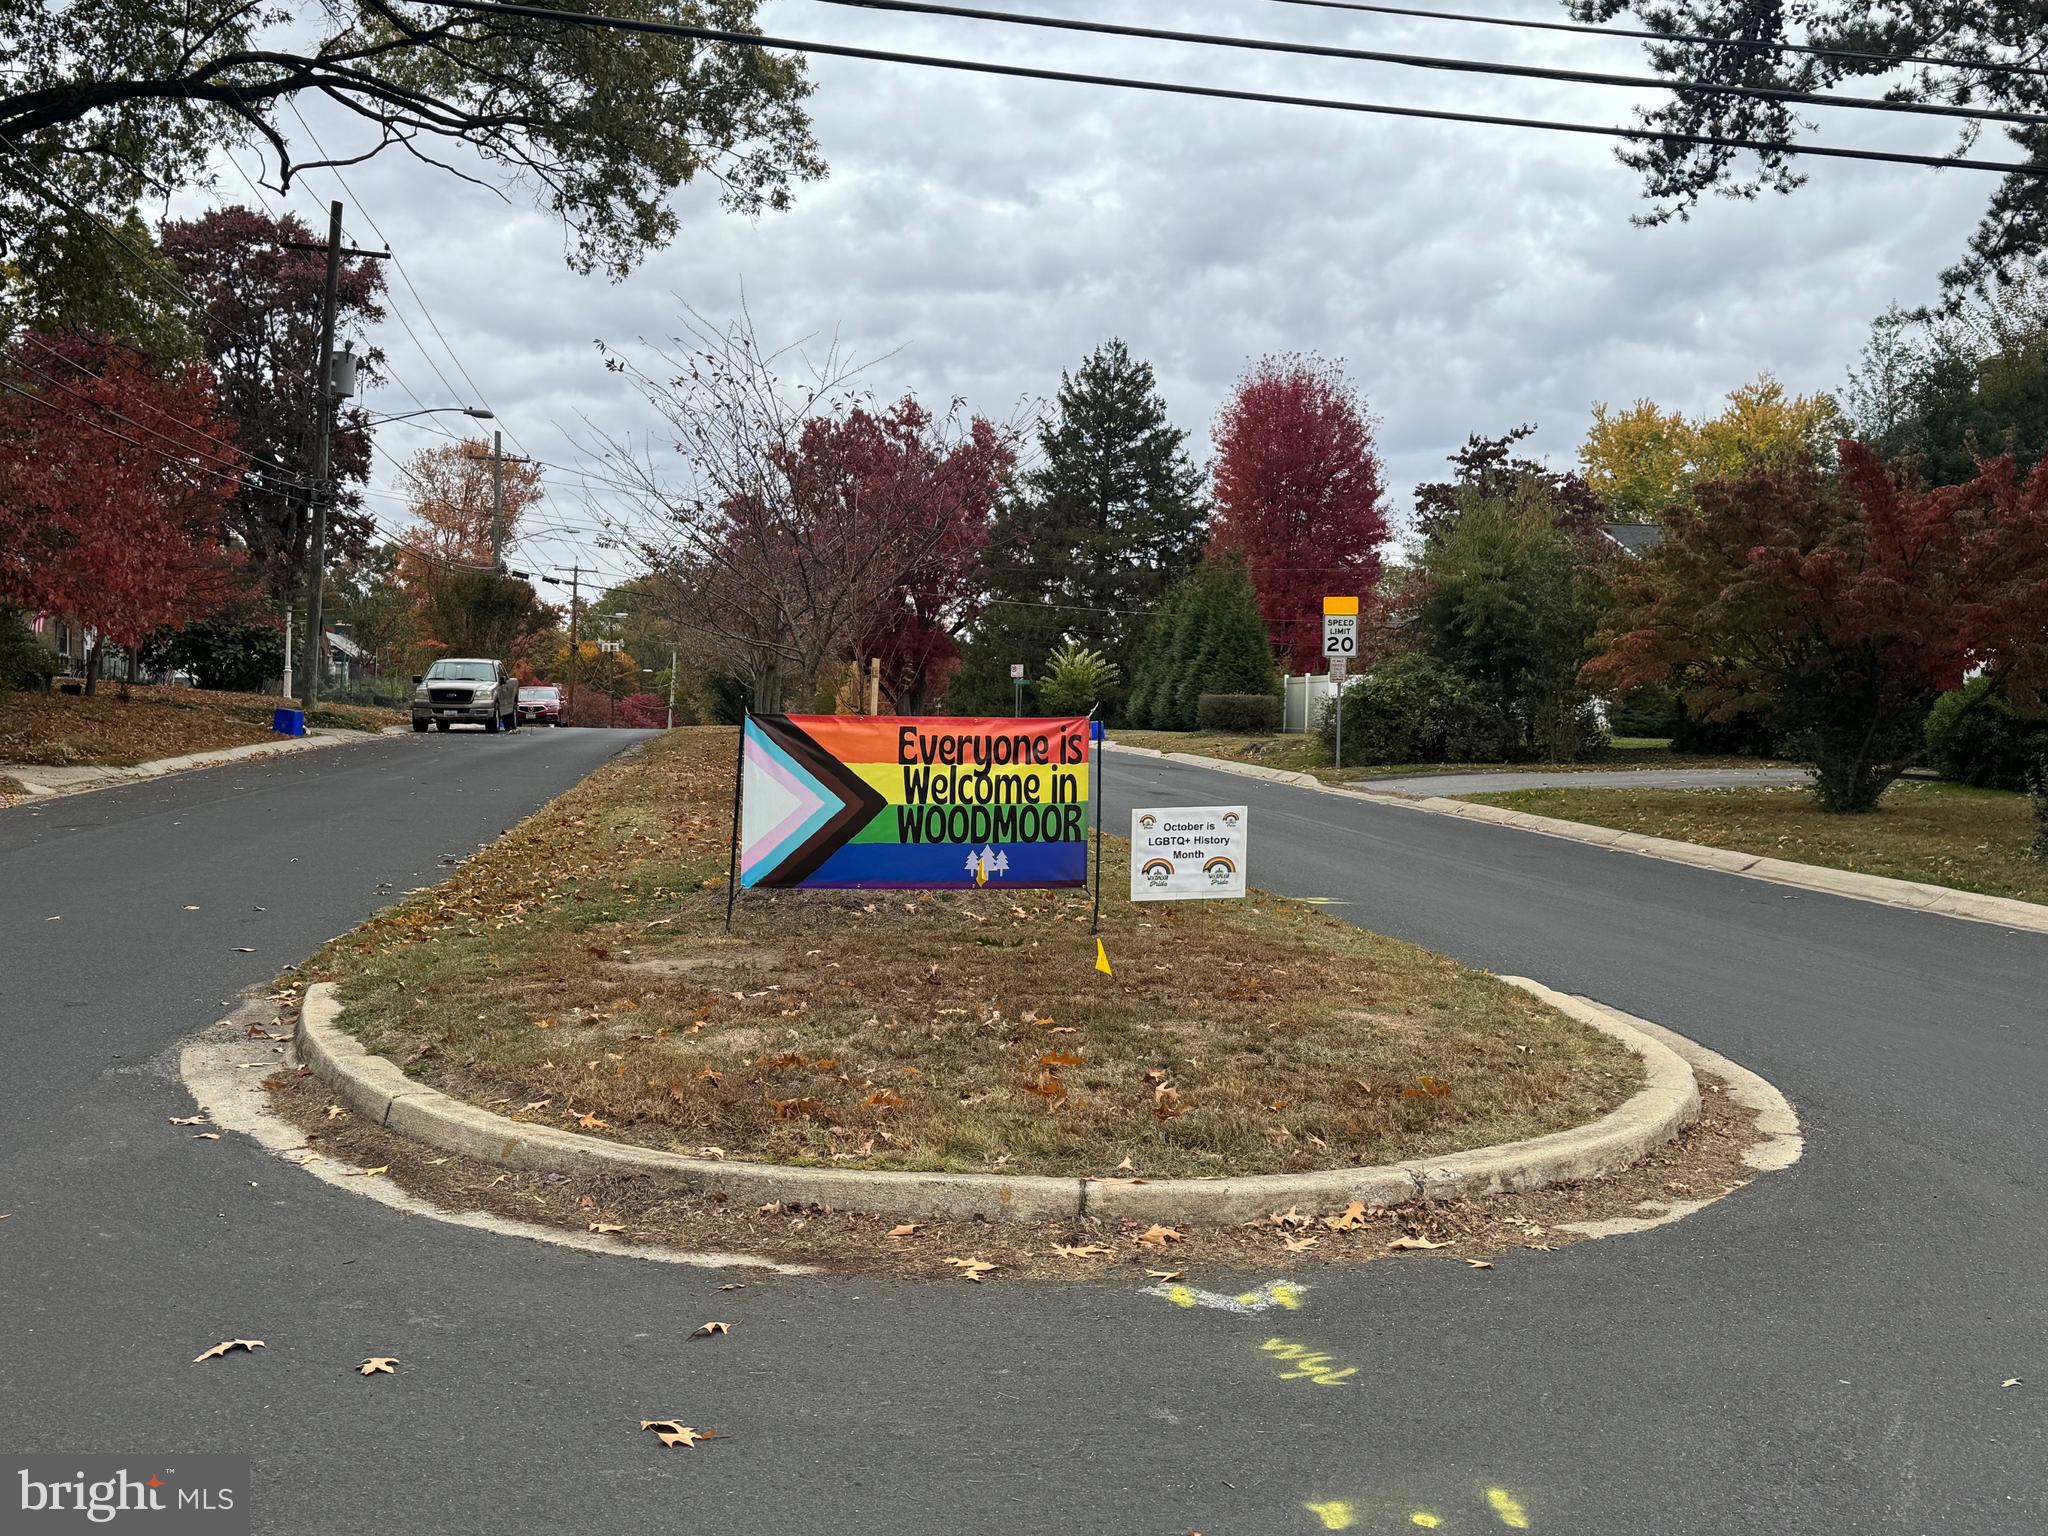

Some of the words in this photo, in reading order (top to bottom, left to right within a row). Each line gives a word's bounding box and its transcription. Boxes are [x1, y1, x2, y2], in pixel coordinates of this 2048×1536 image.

[1327, 636, 1354, 652] 20
[898, 726, 1050, 777] Everyone
[1060, 725, 1083, 765] is
[903, 765, 1041, 805] Welcome
[1051, 765, 1078, 804] in
[897, 804, 1082, 844] WOODMOOR
[1163, 822, 1204, 832] October
[1206, 821, 1216, 831] is
[1148, 836, 1191, 846] LGBTQ+
[1193, 835, 1231, 846] History
[1173, 850, 1205, 860] Month
